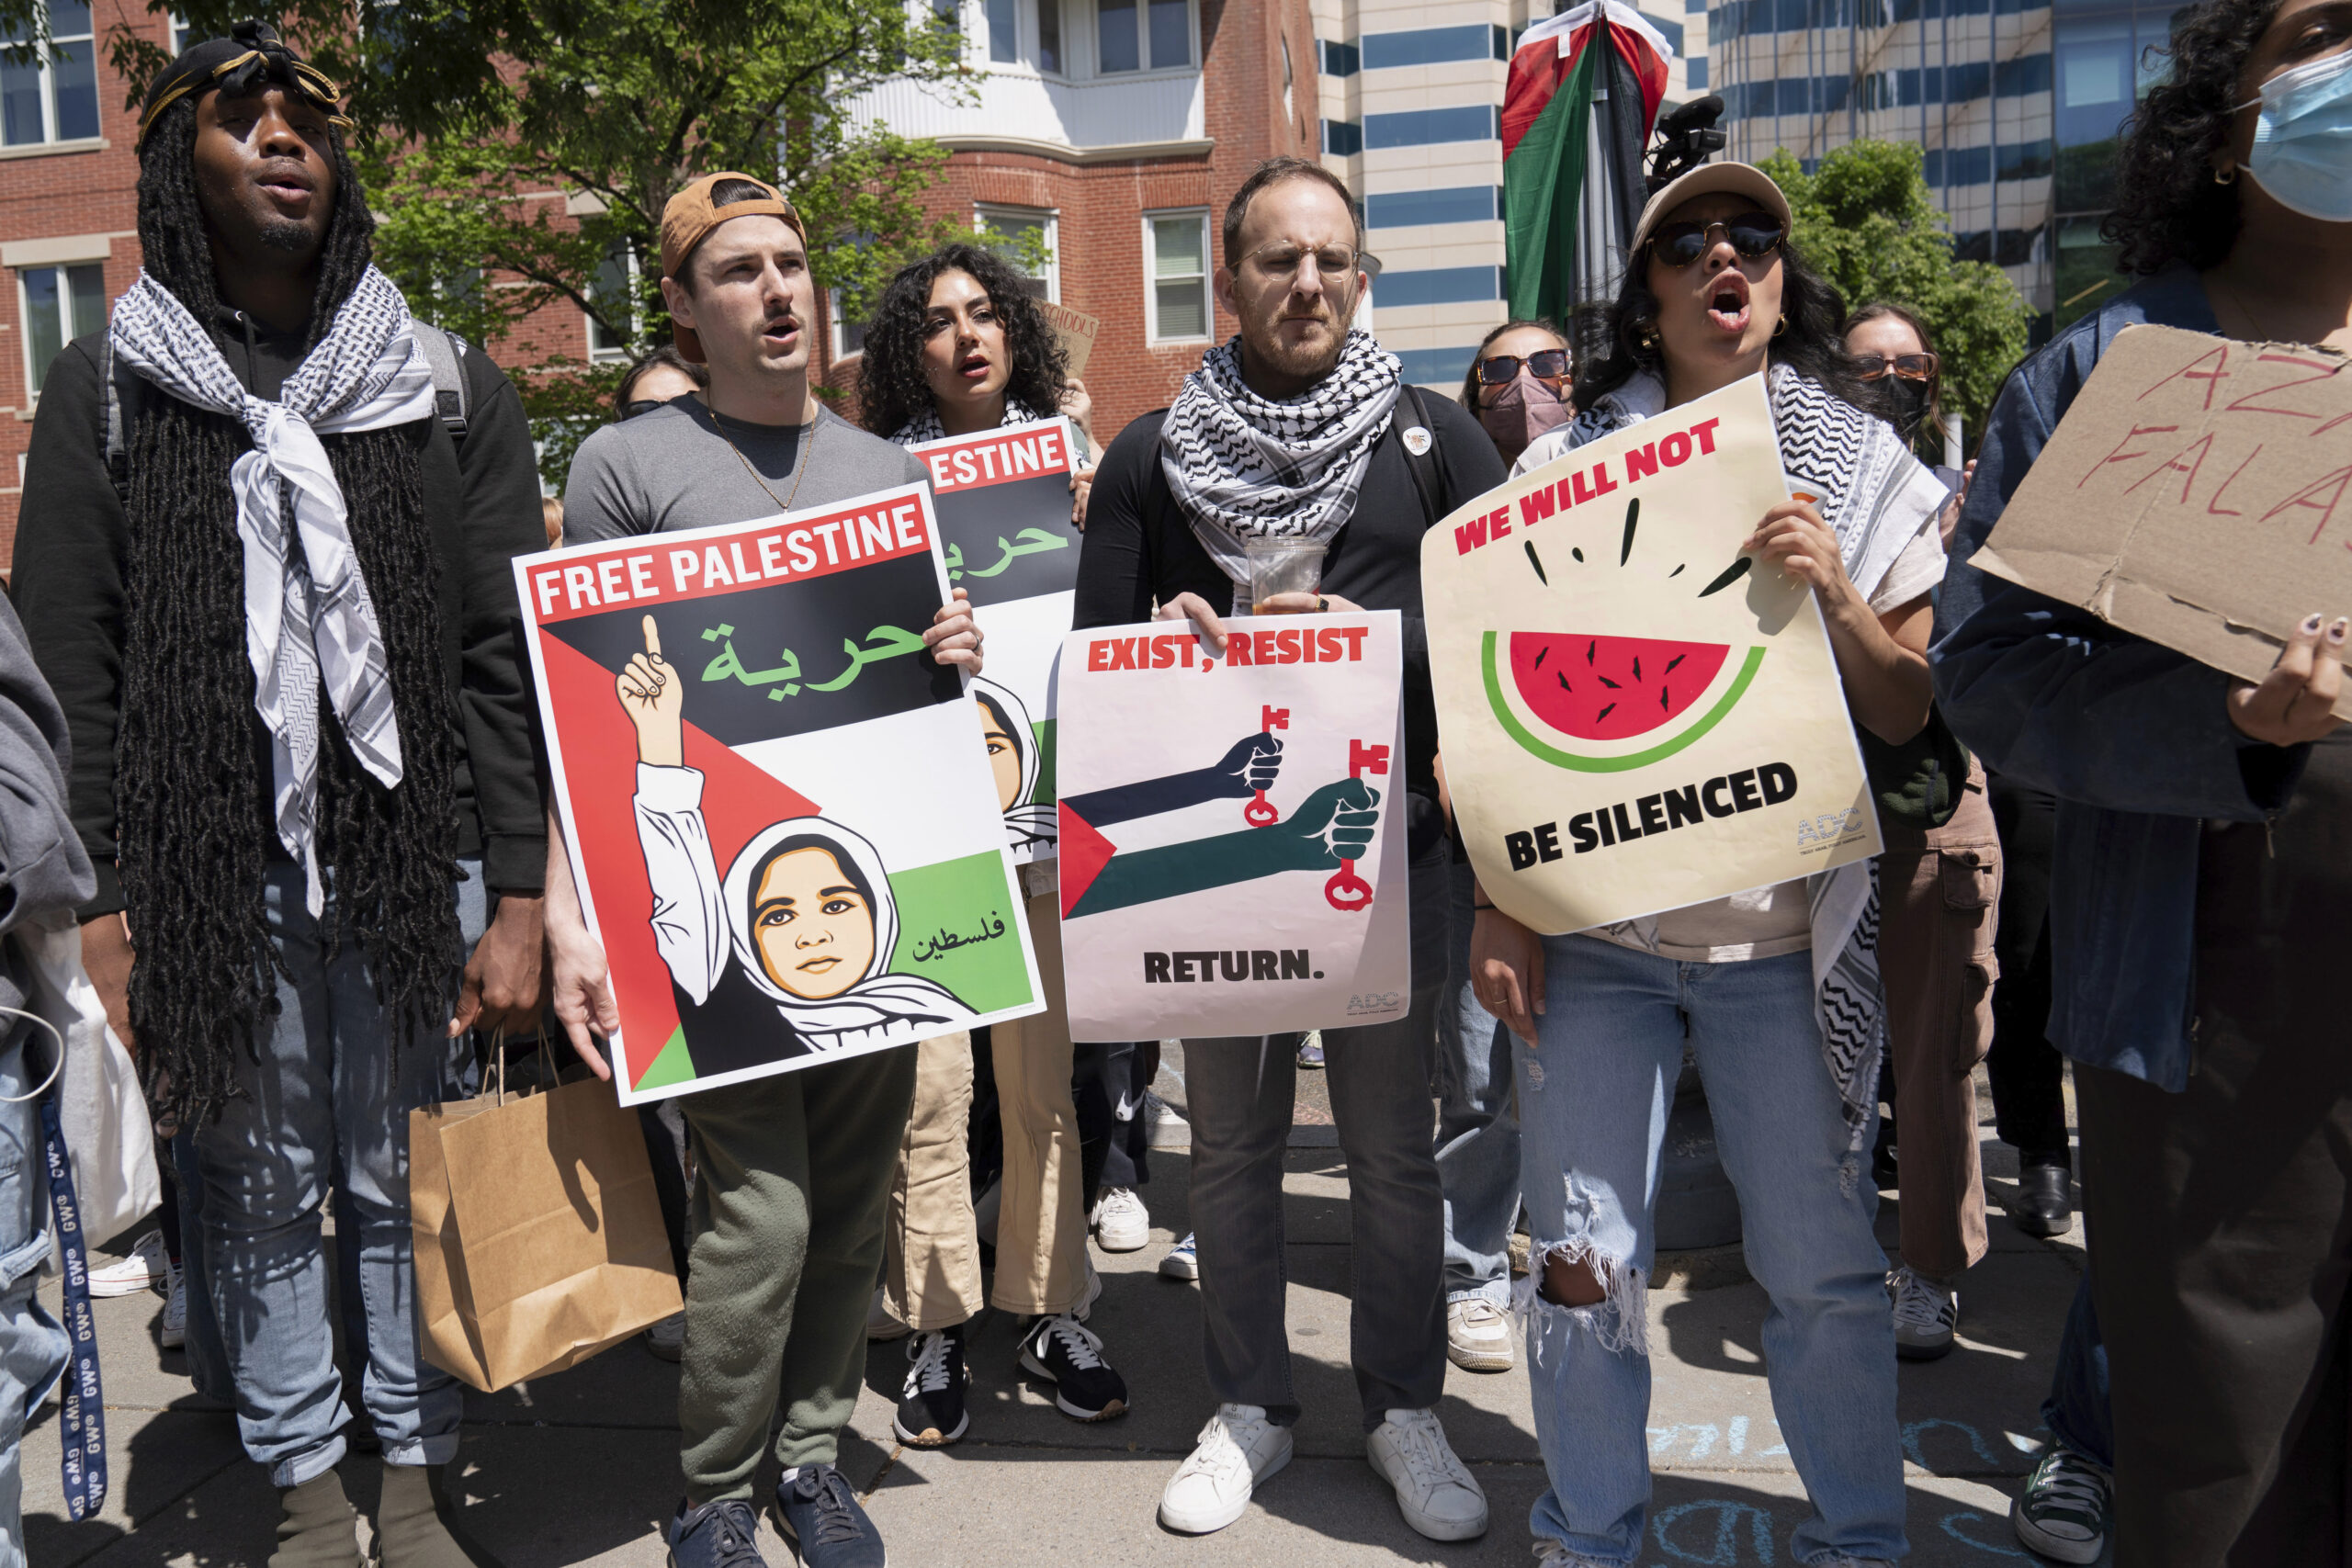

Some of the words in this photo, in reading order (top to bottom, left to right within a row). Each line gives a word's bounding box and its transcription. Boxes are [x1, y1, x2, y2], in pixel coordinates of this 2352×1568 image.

[929, 433, 1064, 489] ESTINE
[1453, 503, 1512, 557] WE
[1519, 461, 1618, 527] WILL
[1626, 416, 1720, 484] NOT
[2077, 423, 2352, 551] FALA
[535, 553, 661, 616] FREE
[671, 502, 923, 592] PALESTINE
[700, 622, 930, 703] حرية
[1087, 634, 1215, 674] EXIST,
[1226, 626, 1369, 668] RESIST
[1503, 818, 1565, 872] BE
[1567, 761, 1798, 855] SILENCED
[1797, 807, 1864, 846] ADC
[912, 910, 1005, 963] فلسطين
[1143, 948, 1325, 984] RETURN.
[1346, 991, 1398, 1010] ADC
